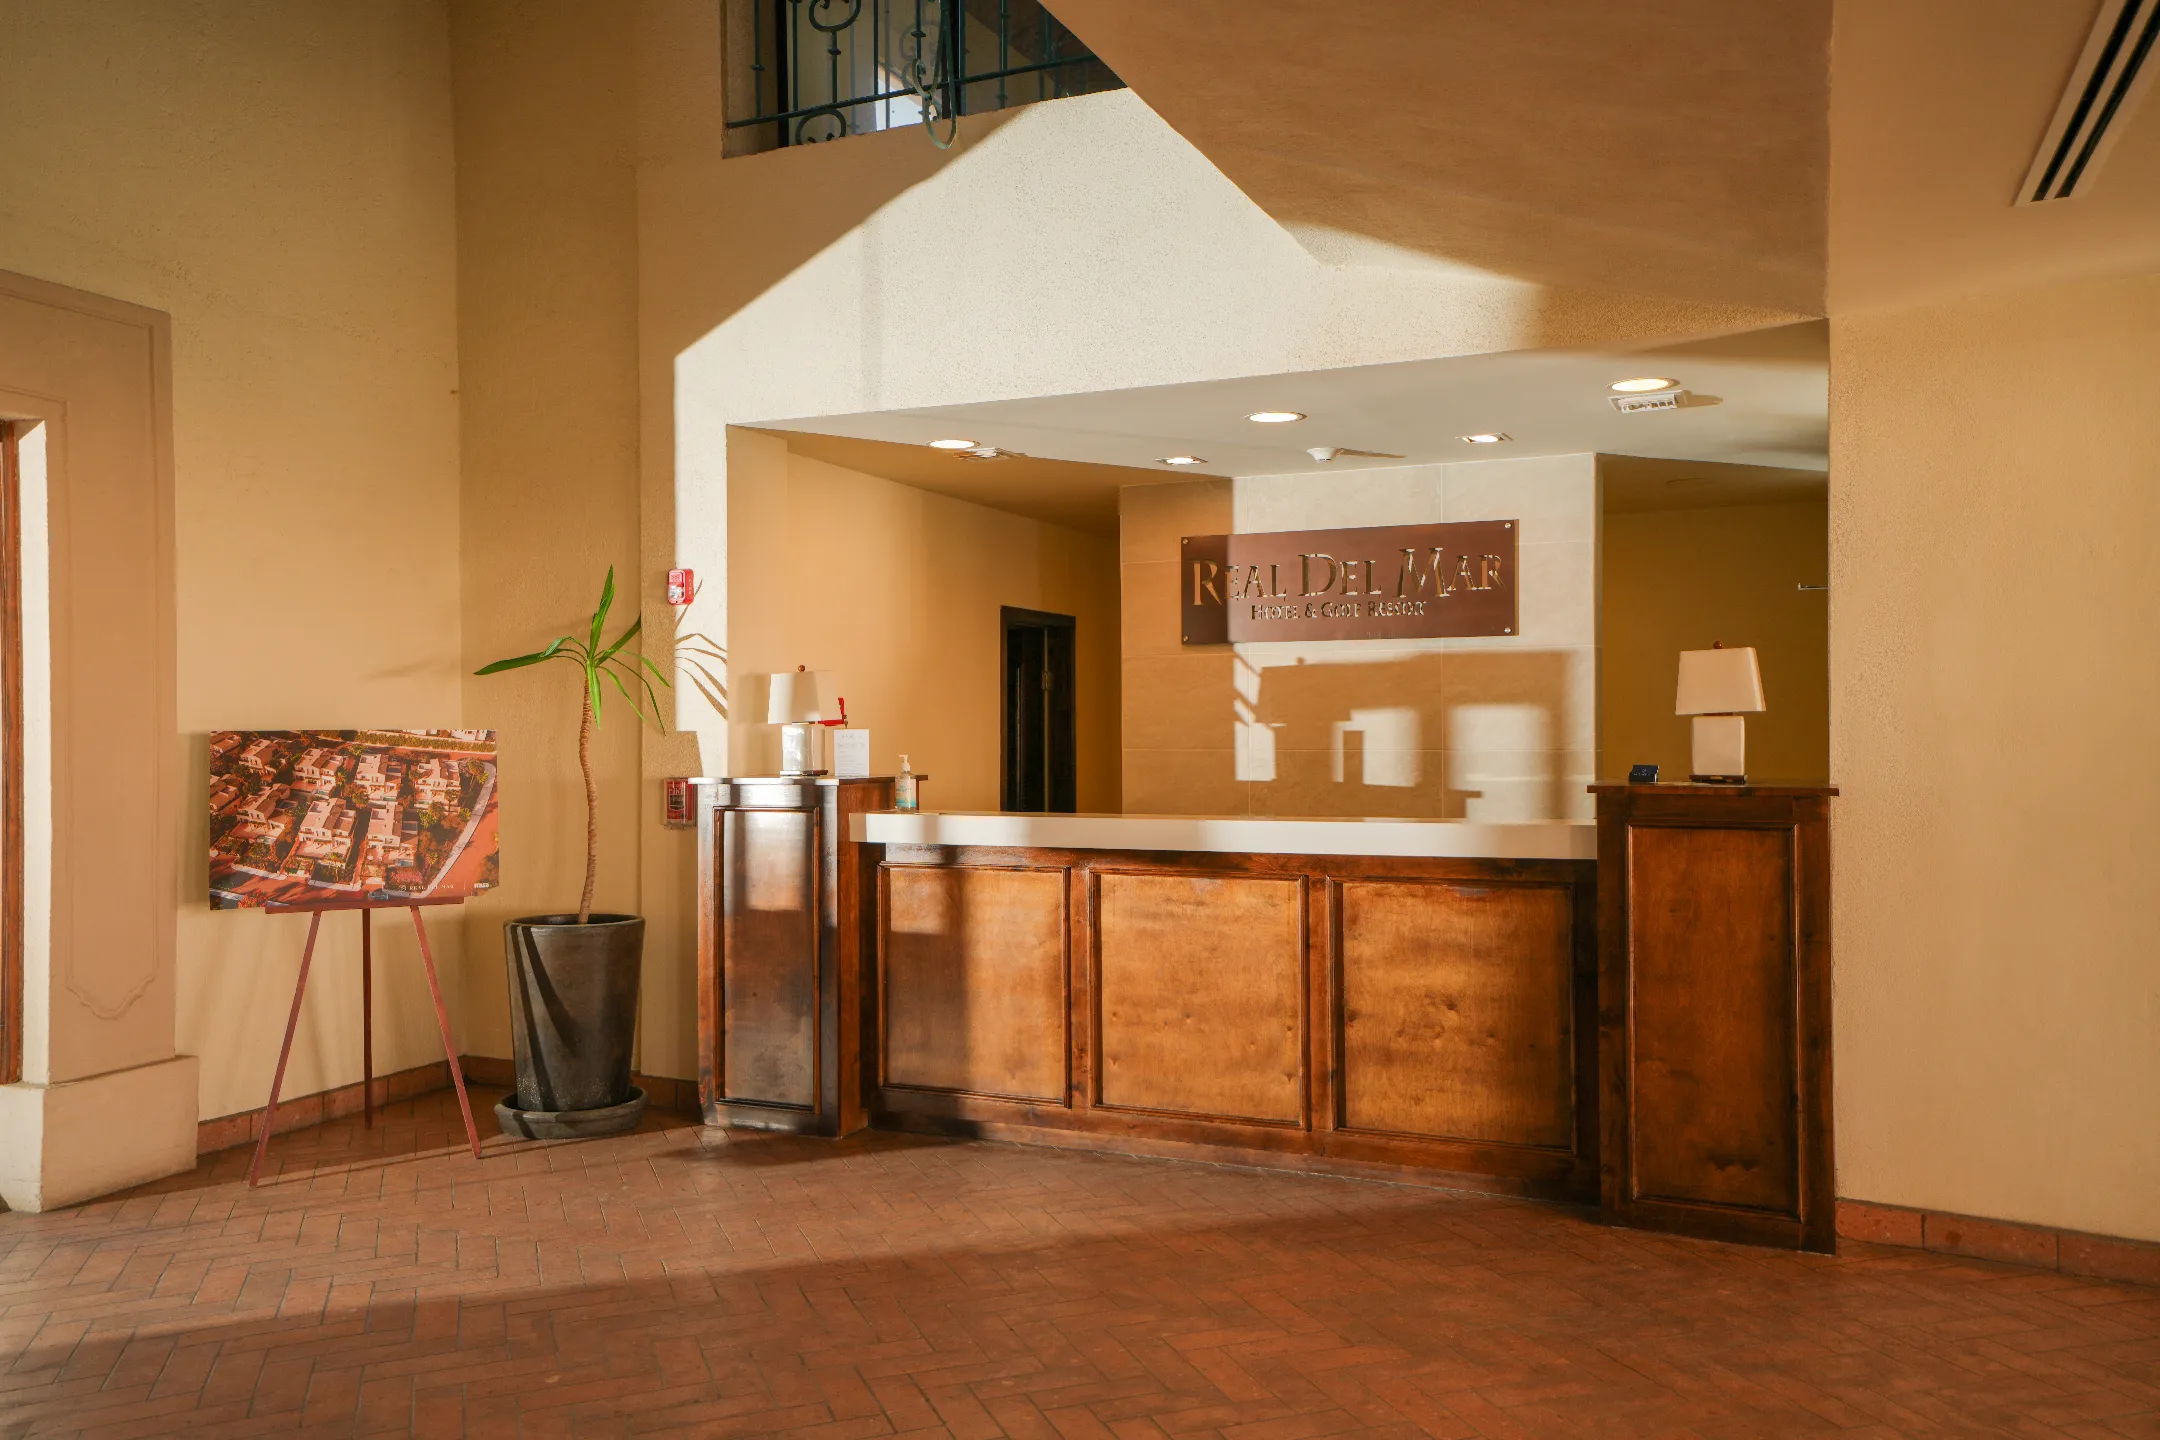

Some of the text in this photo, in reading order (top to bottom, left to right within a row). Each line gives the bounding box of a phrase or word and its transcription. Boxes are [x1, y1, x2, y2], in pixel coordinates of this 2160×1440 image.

[1188, 546, 1508, 607] REAL DEL MAR
[1251, 600, 1427, 620] HOTEL & GOLF RESORT
